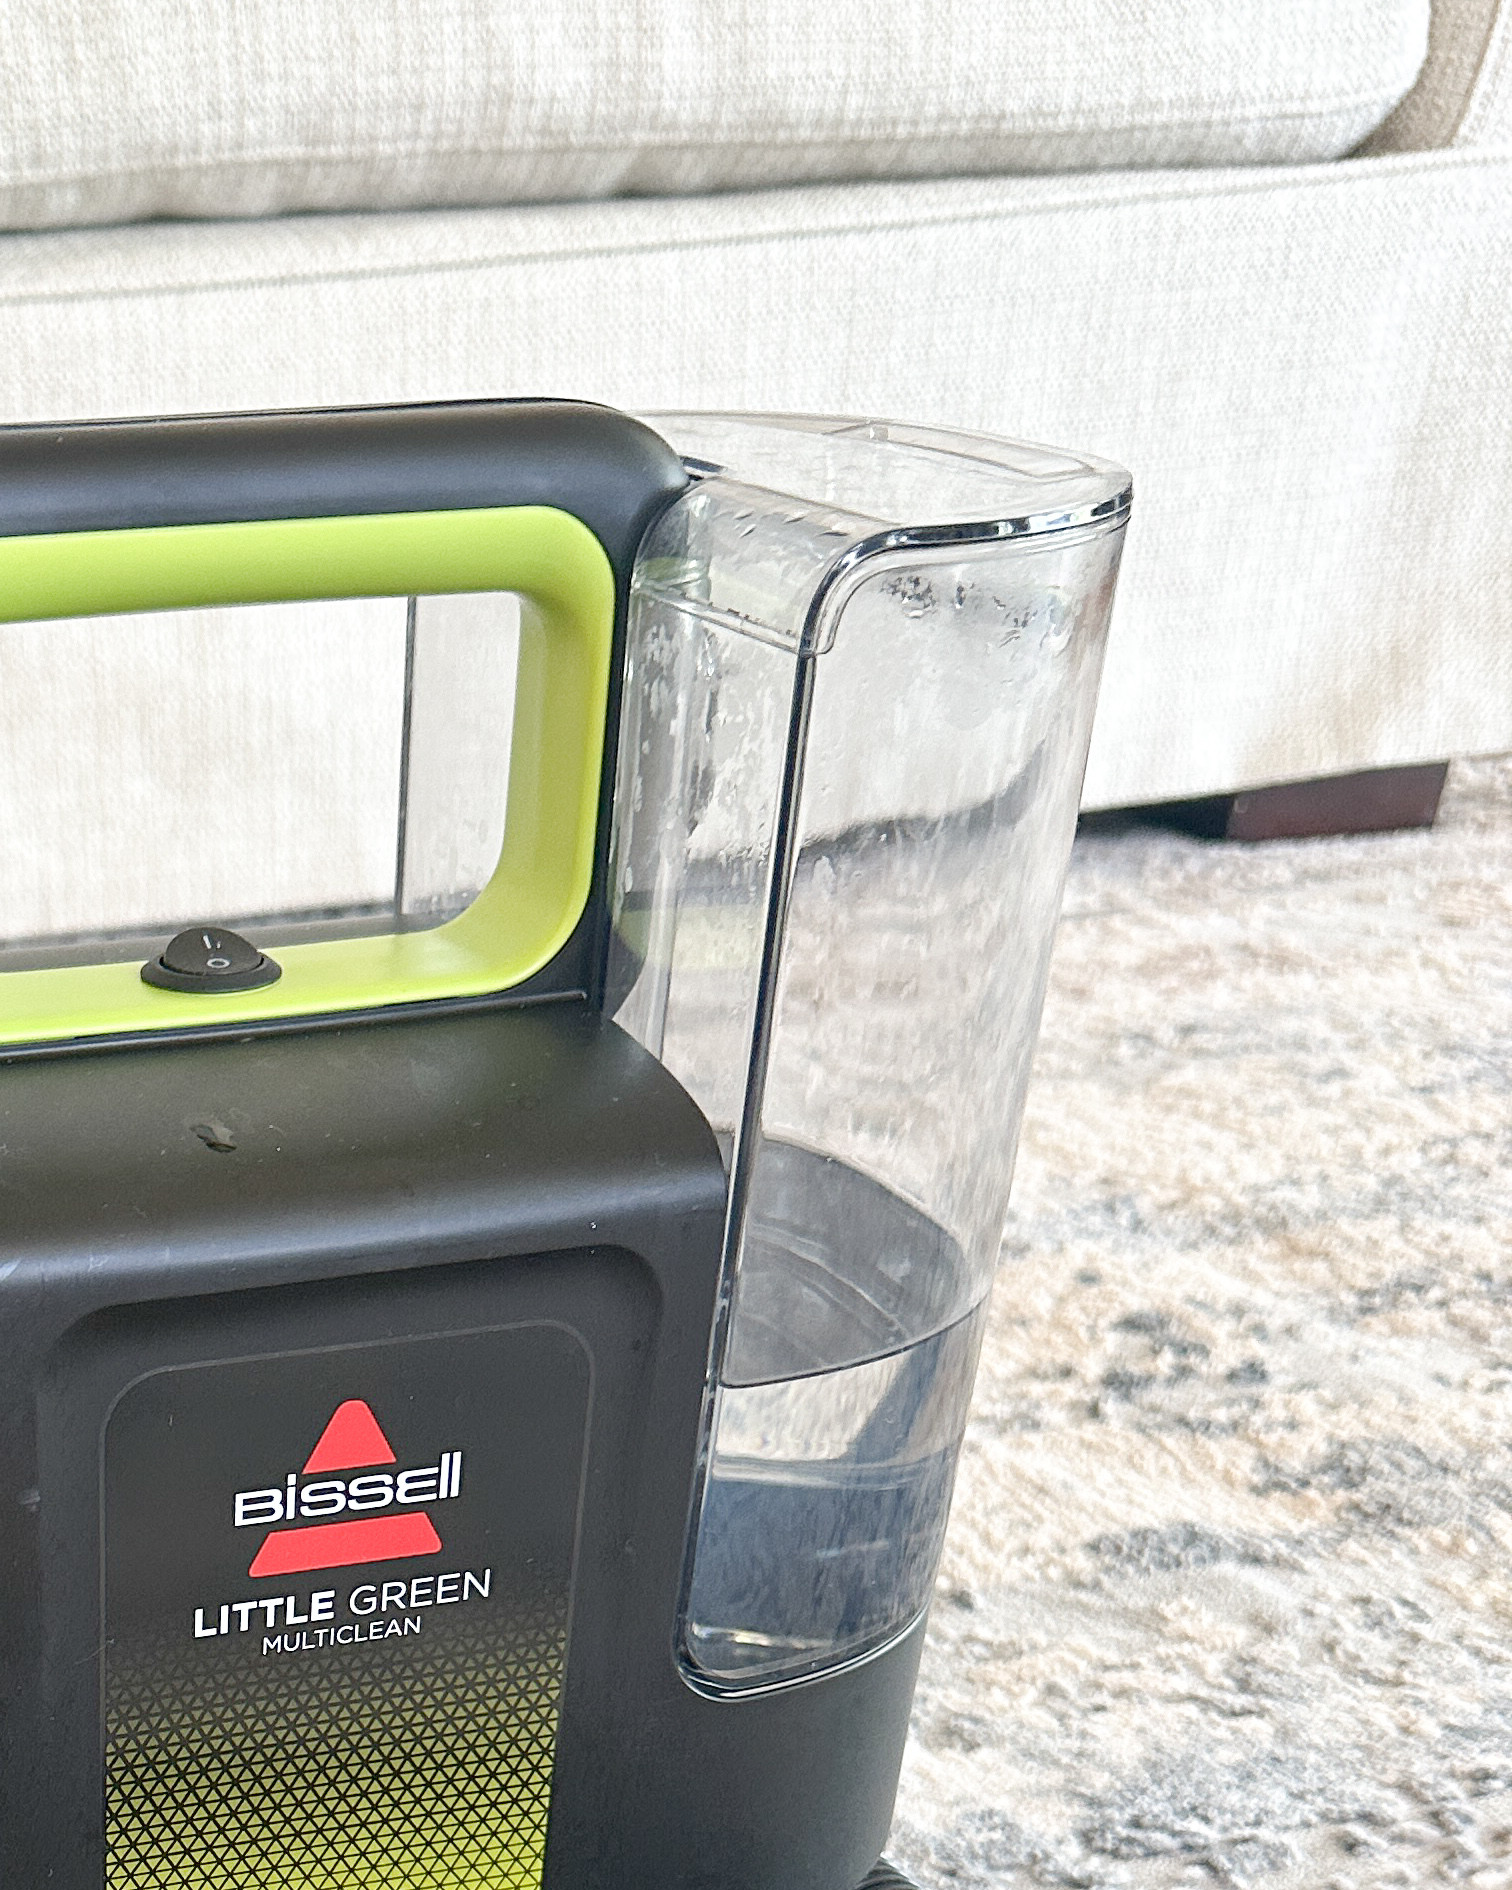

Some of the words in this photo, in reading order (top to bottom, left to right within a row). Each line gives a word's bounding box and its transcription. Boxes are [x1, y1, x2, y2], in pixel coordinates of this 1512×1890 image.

[193, 1590, 337, 1639] LITTLE
[349, 1568, 492, 1615] GREEN
[261, 1616, 422, 1656] MULTICLEAN
